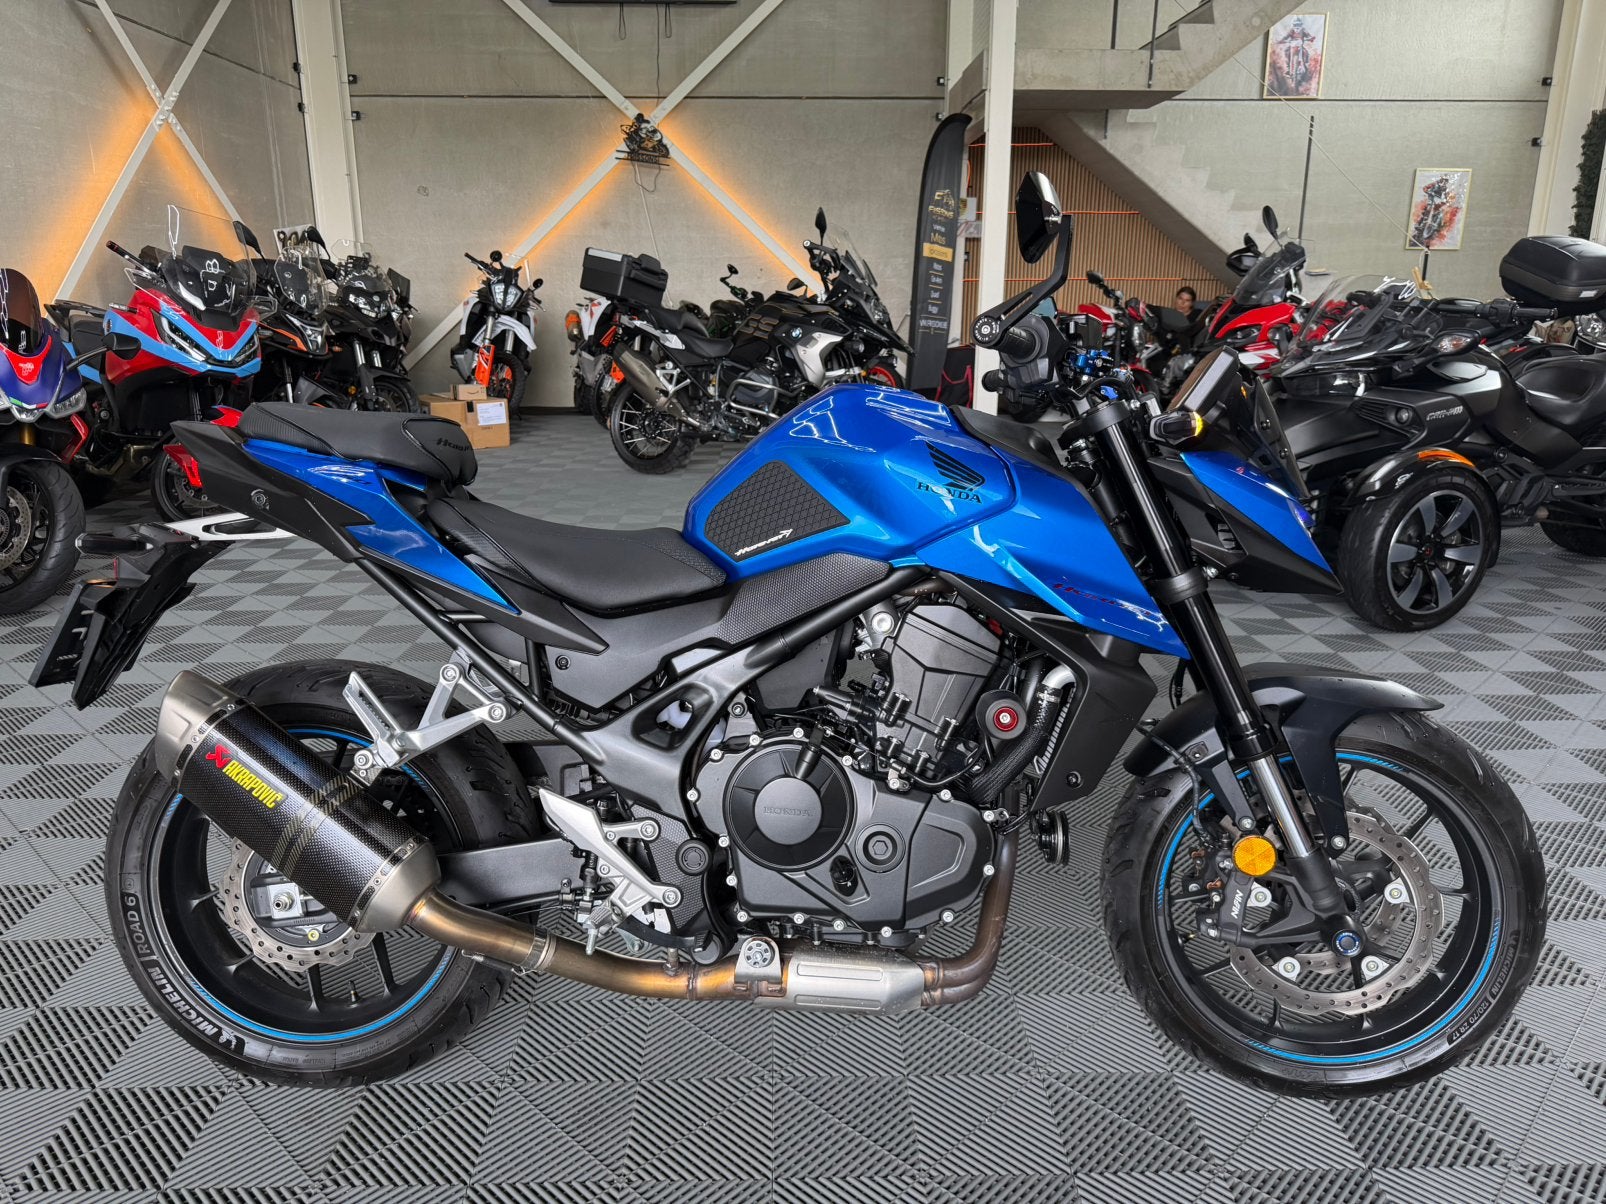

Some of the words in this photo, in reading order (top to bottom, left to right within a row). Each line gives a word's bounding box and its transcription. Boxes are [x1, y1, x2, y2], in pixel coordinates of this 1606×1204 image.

[917, 481, 983, 504] HONDA
[763, 805, 813, 817] HONDA
[128, 895, 137, 907] 6
[1230, 888, 1244, 919] NISSIN
[127, 910, 151, 956] ROAD
[1490, 949, 1516, 997] MICHELIN
[148, 966, 219, 1037] MICHELIN
[1469, 1000, 1489, 1024] 120/70
